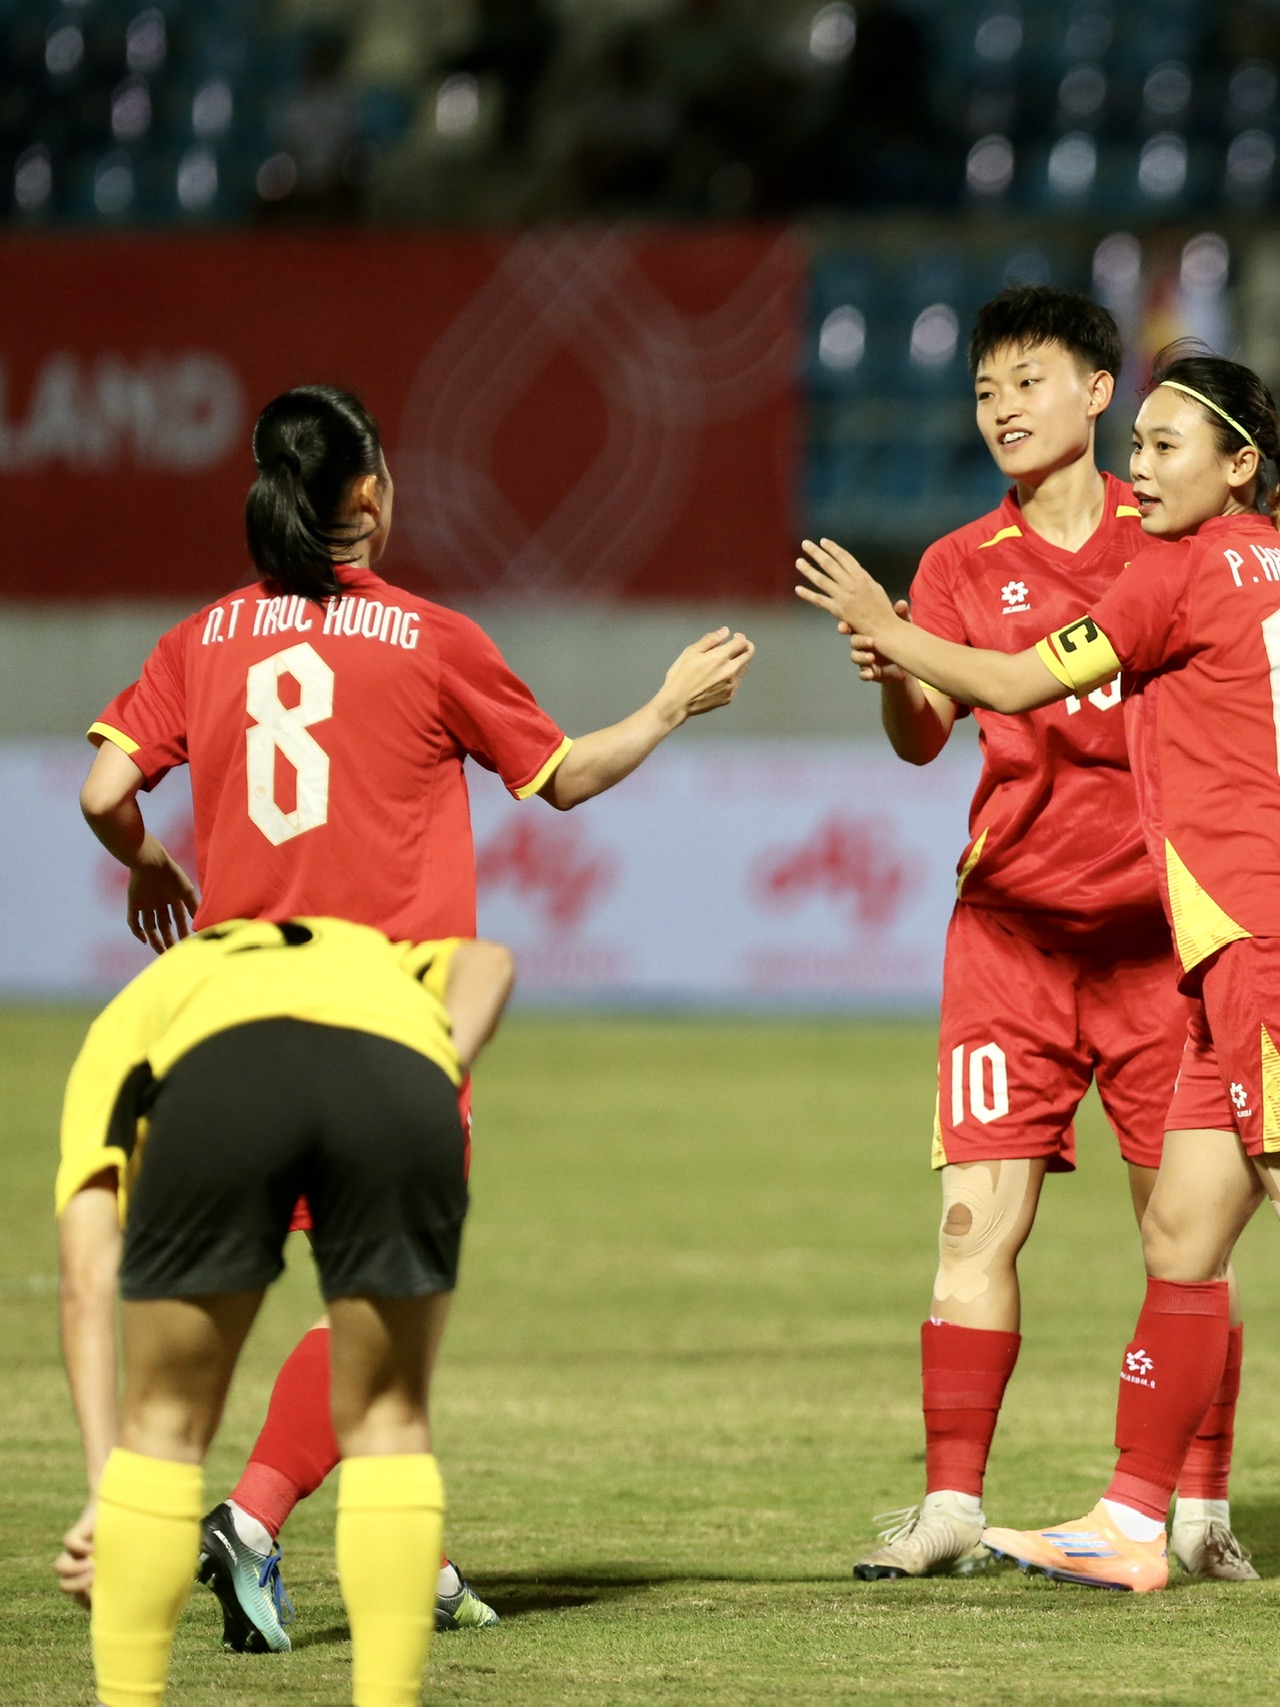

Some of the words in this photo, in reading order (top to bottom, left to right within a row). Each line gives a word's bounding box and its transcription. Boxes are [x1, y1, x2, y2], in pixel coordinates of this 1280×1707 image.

[1058, 617, 1098, 653] C
[246, 641, 334, 846] 8
[951, 1041, 1010, 1128] 10
